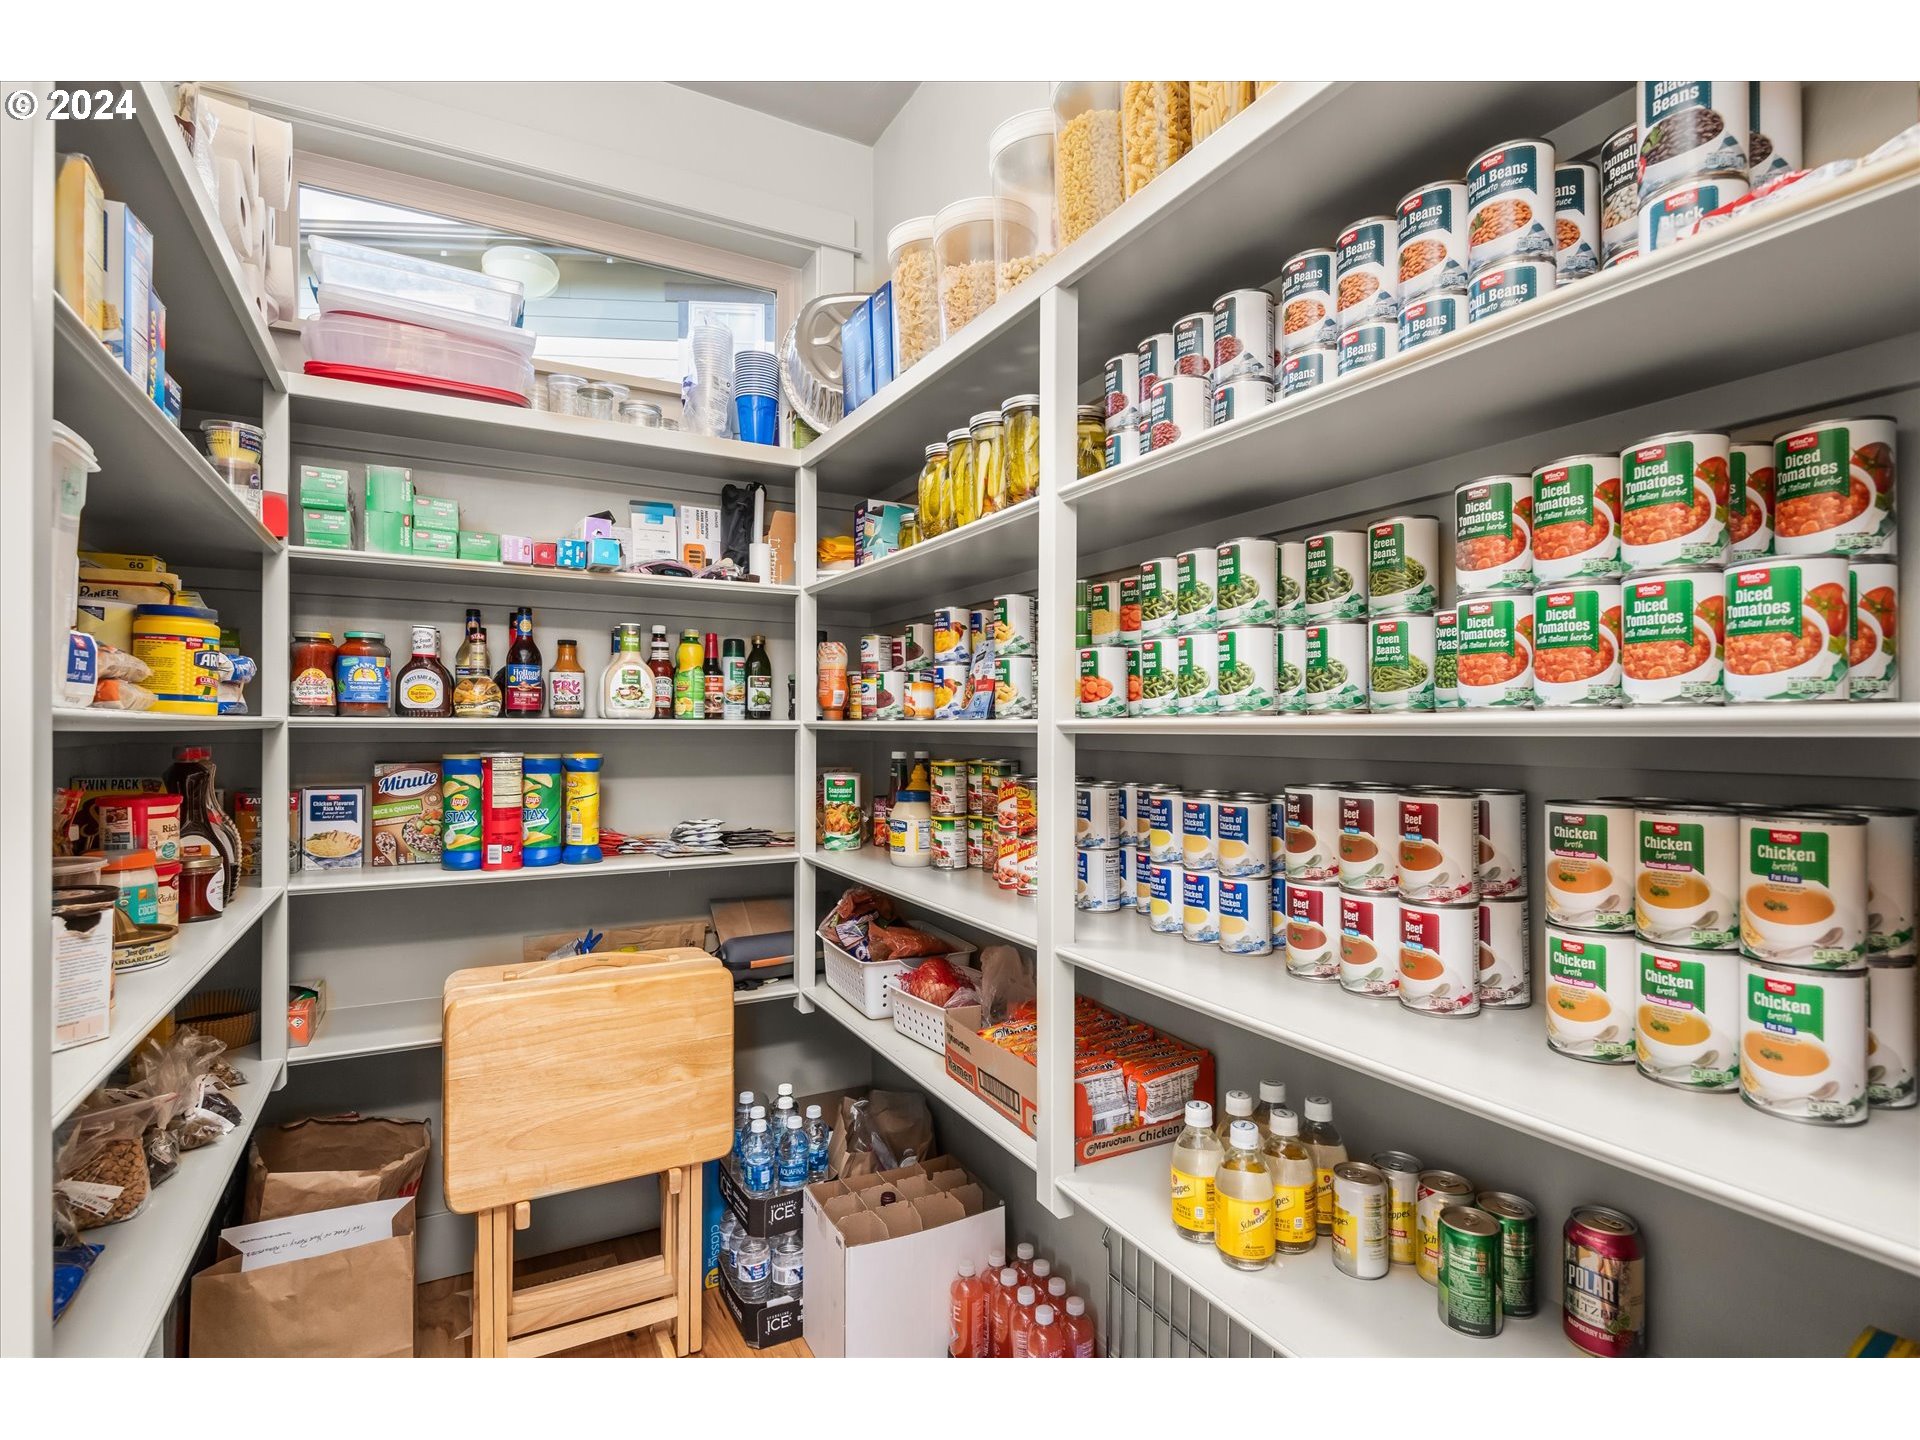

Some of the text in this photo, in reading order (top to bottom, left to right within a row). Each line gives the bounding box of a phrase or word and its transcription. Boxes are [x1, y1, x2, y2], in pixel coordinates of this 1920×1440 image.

[1654, 81, 1697, 100] Blac
[1652, 86, 1699, 117] Beans
[1603, 146, 1639, 177] Cannell
[1490, 165, 1528, 187] Beans
[1408, 205, 1443, 226] Beans
[1347, 239, 1376, 258] Beans
[1295, 269, 1323, 287] Beans
[1489, 283, 1528, 305] Beans
[1413, 314, 1447, 335] Beans
[1347, 341, 1377, 360] Beans
[1288, 370, 1316, 388] Beans
[1785, 449, 1820, 468] Diced
[1633, 462, 1669, 480] Diced
[1778, 461, 1839, 486] Tomatoes
[1541, 483, 1571, 500] Diced
[1625, 475, 1684, 498] Tomatoes
[1465, 500, 1493, 515] Diced
[1535, 494, 1586, 514] Tomatoes
[1459, 511, 1505, 528] Tomatoes
[1373, 538, 1397, 551] Green
[1308, 550, 1326, 560] Green
[1373, 549, 1398, 562] Beans
[129, 561, 145, 570] 60
[1308, 559, 1327, 570] Beans
[1736, 586, 1773, 603] Diced
[1545, 607, 1577, 622] Diced
[1634, 600, 1669, 614] Diced
[1728, 600, 1792, 621] Tomatoes
[1467, 616, 1495, 628] Diced
[1537, 619, 1591, 637] Tomatoes
[1626, 611, 1684, 630] Tomatoes
[1376, 635, 1400, 646] Green
[1436, 627, 1457, 639] Swee
[1460, 629, 1507, 645] Tomatoes
[1376, 646, 1401, 658] Beans
[1438, 639, 1458, 651] Peas
[513, 668, 541, 678] Holland
[517, 674, 540, 682] House
[553, 679, 581, 695] FRY
[79, 778, 140, 791] TWIN PACK
[379, 772, 439, 794] Minute
[312, 800, 332, 808] Chicken
[373, 803, 421, 816] RICE QUINOA
[1287, 802, 1300, 814] Beef
[445, 810, 478, 824] STAX
[1344, 808, 1360, 820] Beef
[1404, 813, 1422, 826] Beef
[1563, 815, 1582, 823] WinCo
[1553, 825, 1597, 841] Chicken
[1655, 824, 1676, 833] WinCo
[1564, 839, 1584, 849] broth
[1644, 835, 1693, 852] Chicken
[1772, 832, 1797, 842] WinCo
[1656, 850, 1677, 861] broth
[1757, 844, 1816, 863] Chicken
[1772, 861, 1798, 873] broth
[1770, 874, 1799, 883] Fat Free
[1293, 898, 1309, 910] Beef
[1344, 910, 1359, 922] Beef
[1405, 922, 1424, 935] Beef
[1563, 942, 1582, 951] WinCo
[1553, 951, 1596, 971] Chicken
[1656, 958, 1678, 969] WinCo
[1563, 967, 1583, 978] broth
[1645, 968, 1694, 991] Chicken
[1656, 986, 1678, 998] broth
[1767, 980, 1793, 992] WinCo
[1753, 990, 1811, 1015] Chicken
[1767, 1009, 1793, 1024] broth
[1765, 1023, 1795, 1035] Fat Free
[1138, 1124, 1180, 1143] Chicken
[770, 1206, 796, 1223] ICE
[1240, 1209, 1271, 1233] Schweppes
[1276, 1217, 1290, 1225] ONIC
[710, 1223, 720, 1267] classic
[1568, 1263, 1615, 1303] POLAR
[766, 1315, 791, 1334] ICE
